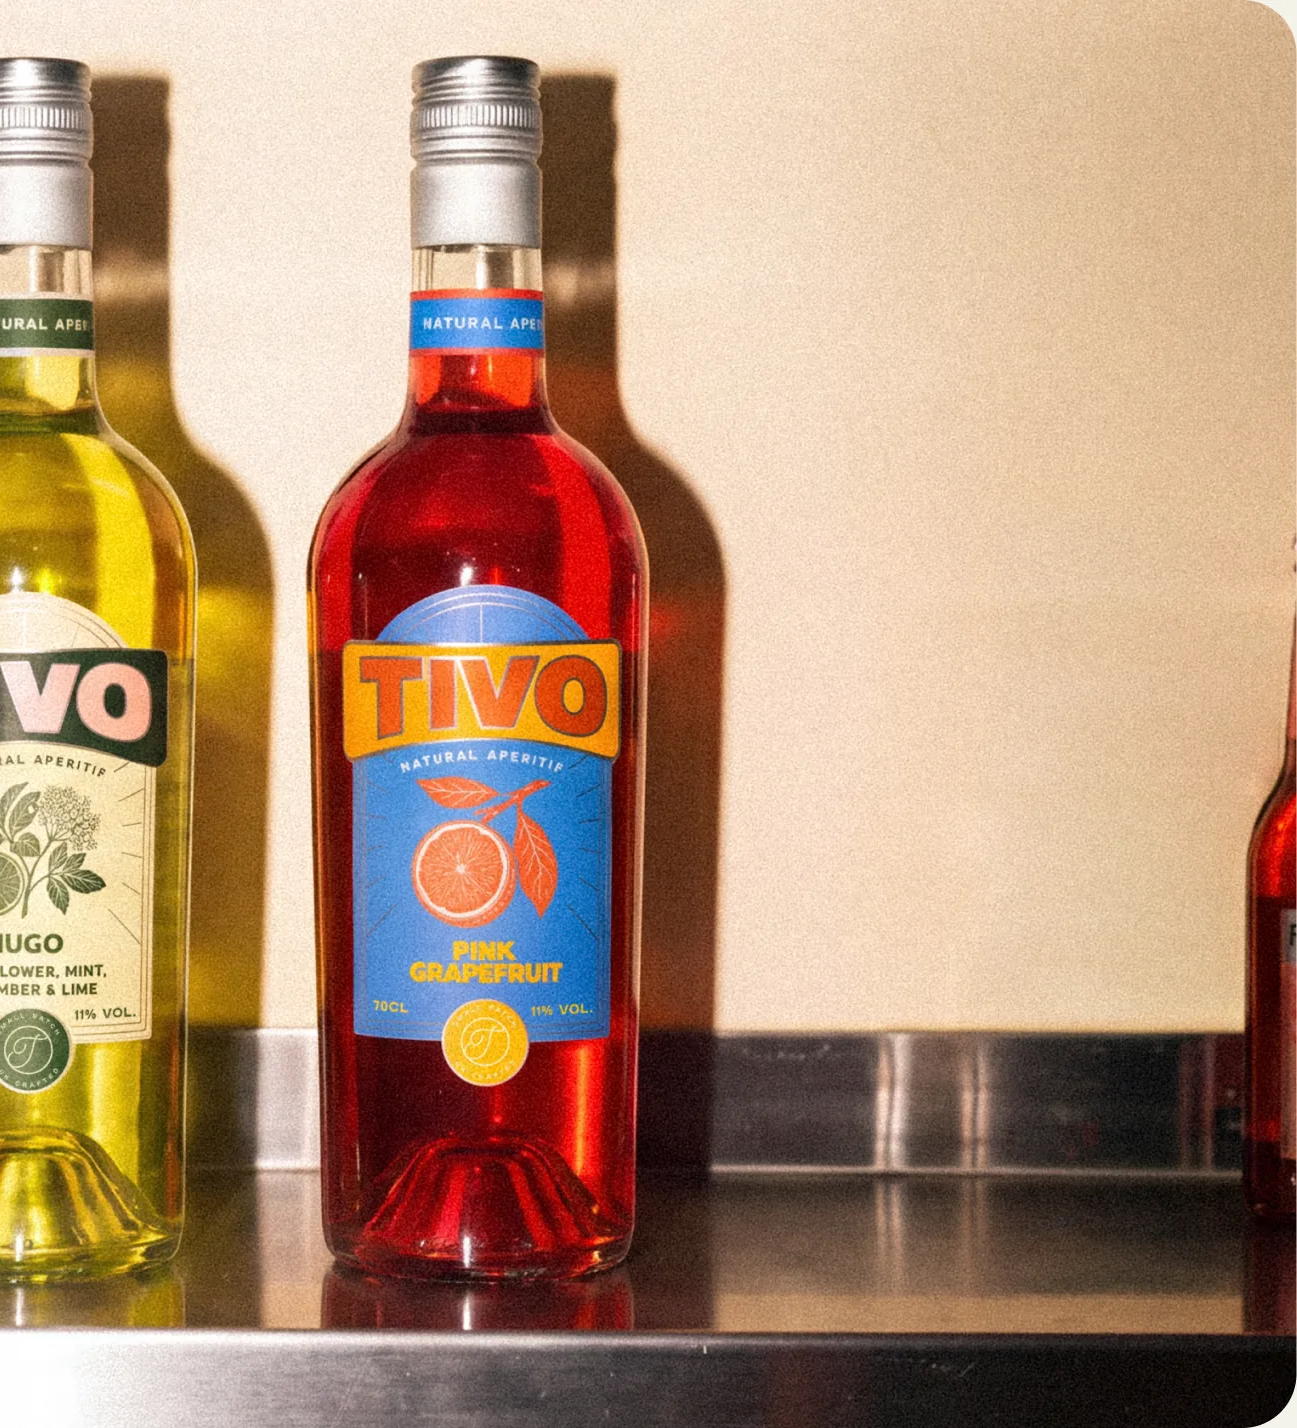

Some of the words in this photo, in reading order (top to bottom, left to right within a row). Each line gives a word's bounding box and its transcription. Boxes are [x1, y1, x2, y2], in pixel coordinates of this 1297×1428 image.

[423, 316, 503, 330] NATURAL
[359, 654, 608, 740] TIVO
[33, 754, 107, 778] APERITIF
[400, 750, 478, 773] NATURAL
[487, 750, 565, 772] APERITIF
[452, 941, 516, 961] PINK
[65, 964, 107, 979] MINT,
[409, 962, 563, 984] GRAPEFRUIT
[46, 983, 56, 996] &
[61, 983, 98, 996] LIME
[74, 1008, 97, 1020] 11%
[102, 1007, 137, 1020] VOL.
[373, 1000, 409, 1013] 70CL
[531, 1005, 553, 1016] 11%
[558, 1003, 594, 1015] VOL.
[32, 1013, 61, 1036] BATCH
[15, 1067, 60, 1089] CRAFTED
